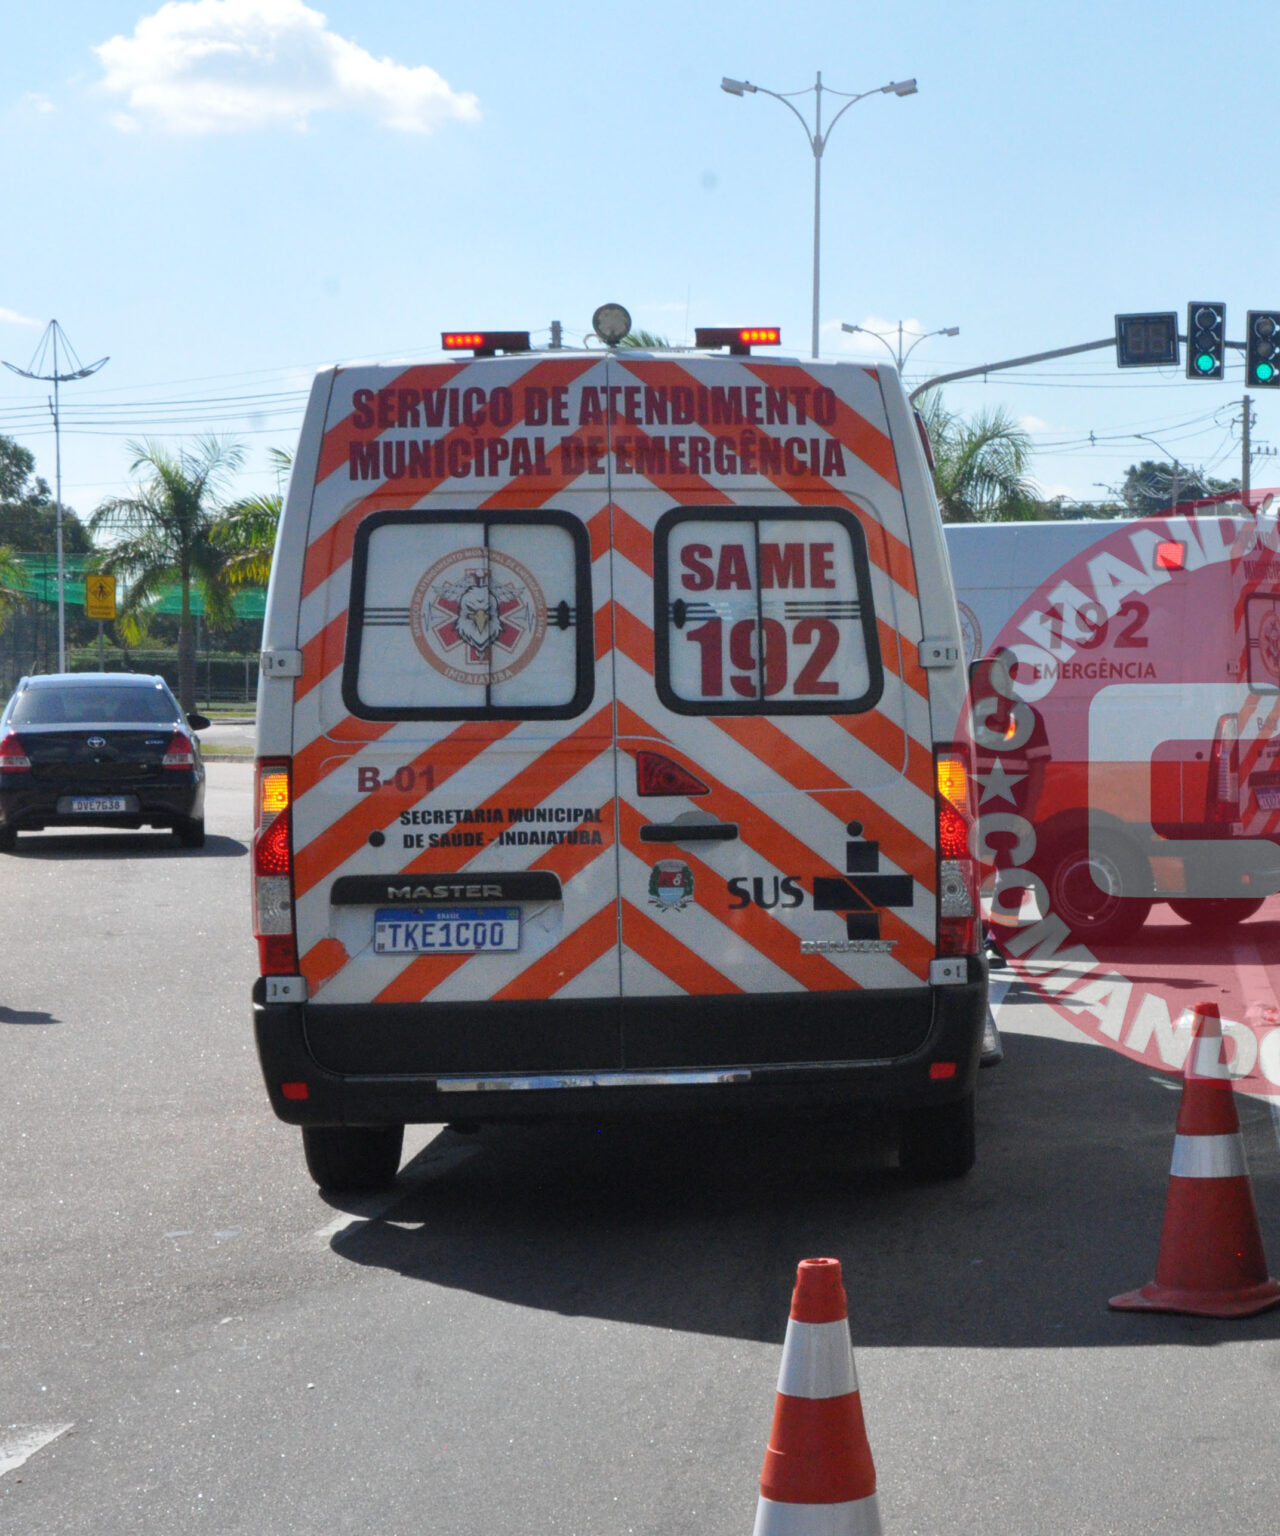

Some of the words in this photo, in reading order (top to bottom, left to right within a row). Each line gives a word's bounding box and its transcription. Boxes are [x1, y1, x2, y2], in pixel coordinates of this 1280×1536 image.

[352, 386, 514, 435] SERVIÇO
[524, 386, 569, 427] DE
[579, 386, 837, 426] ATENDIMENTO
[349, 437, 553, 480] MUNICIPAL
[561, 436, 606, 475] DE
[615, 429, 846, 477] EMERGÊNCIA
[680, 543, 836, 591] SAME
[1039, 600, 1150, 650] 192
[686, 616, 840, 697] 192
[1033, 657, 1156, 679] EMERGÊNCIA
[357, 765, 436, 792] B-01
[400, 810, 503, 826] SECRETARIA
[508, 808, 603, 824] MUNICIPAL
[403, 834, 424, 848] DE
[428, 828, 484, 847] SAÚDE
[499, 830, 603, 846] INDAIATUBA
[387, 884, 503, 899] MASTER
[727, 875, 804, 910] SUS
[388, 922, 504, 948] TKE1C00
